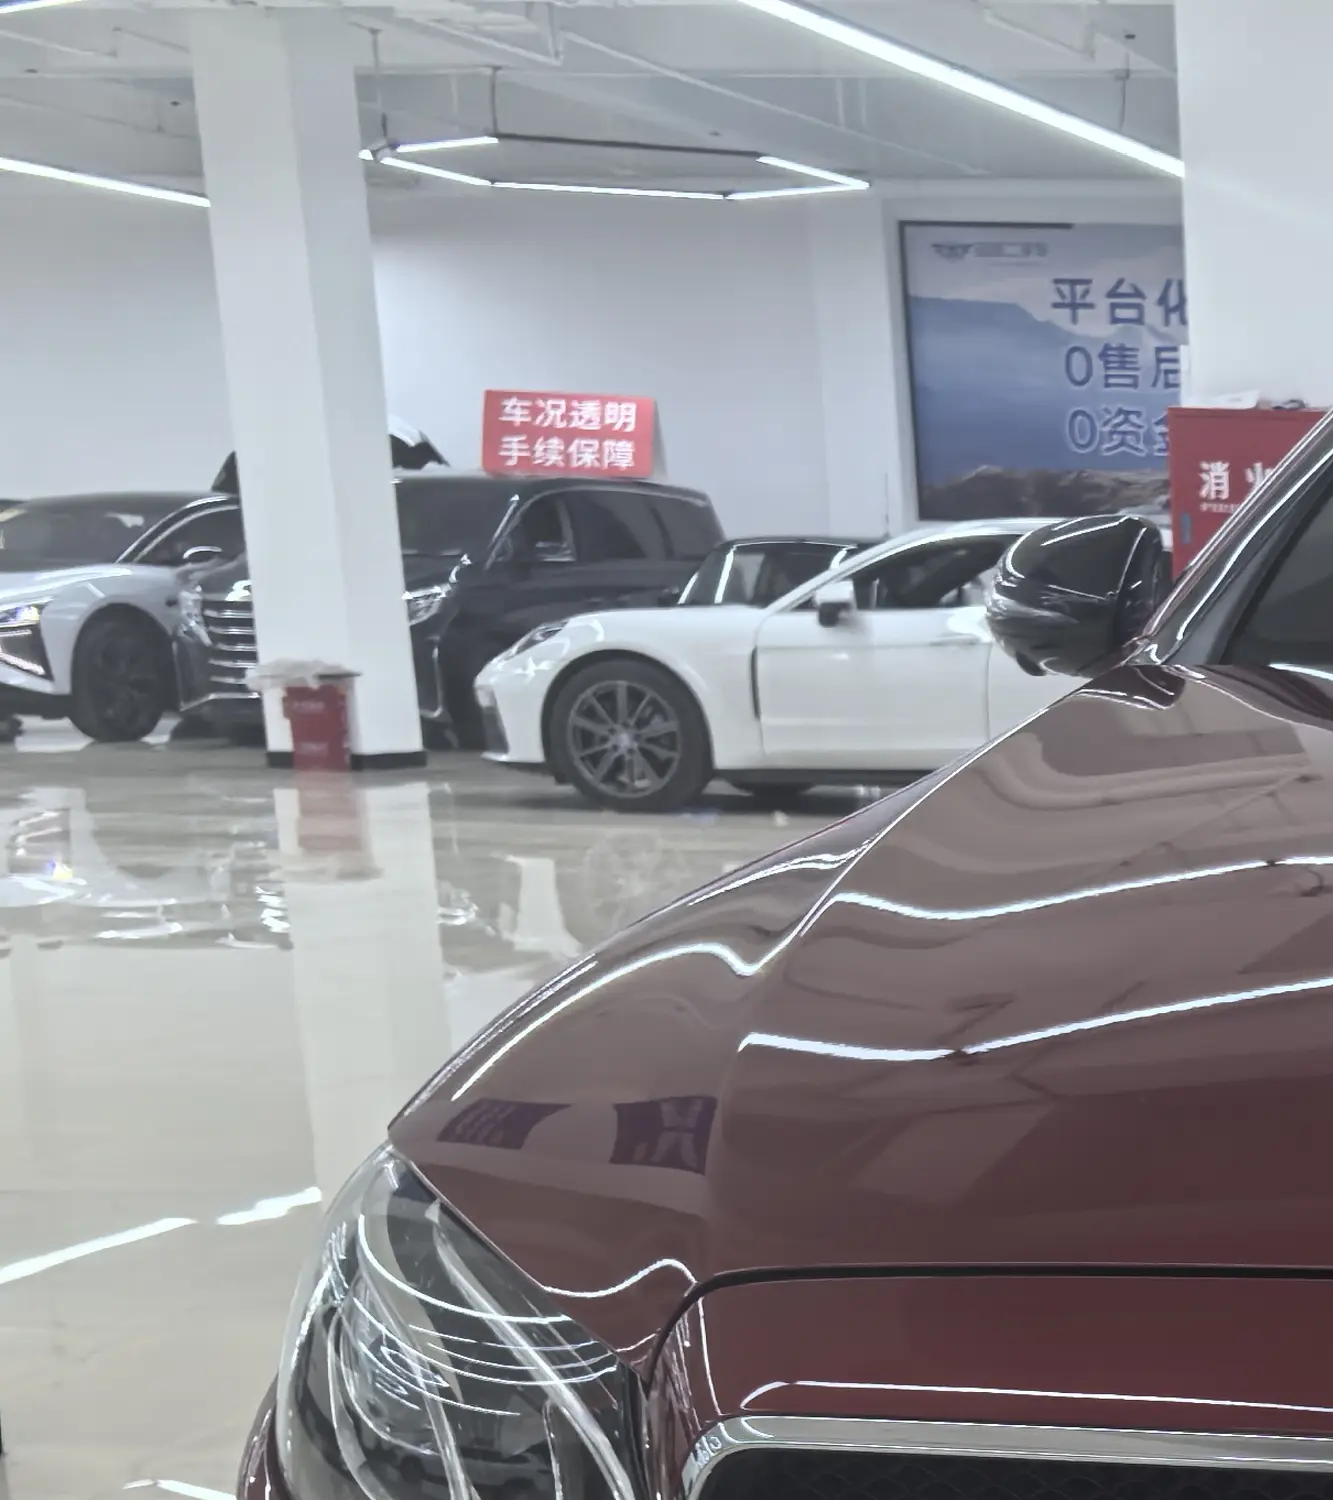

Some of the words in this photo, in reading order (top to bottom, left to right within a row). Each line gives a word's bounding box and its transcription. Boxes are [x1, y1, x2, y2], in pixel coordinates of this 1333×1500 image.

[498, 396, 638, 433] 车况透明
[497, 434, 636, 471] 手续保障
